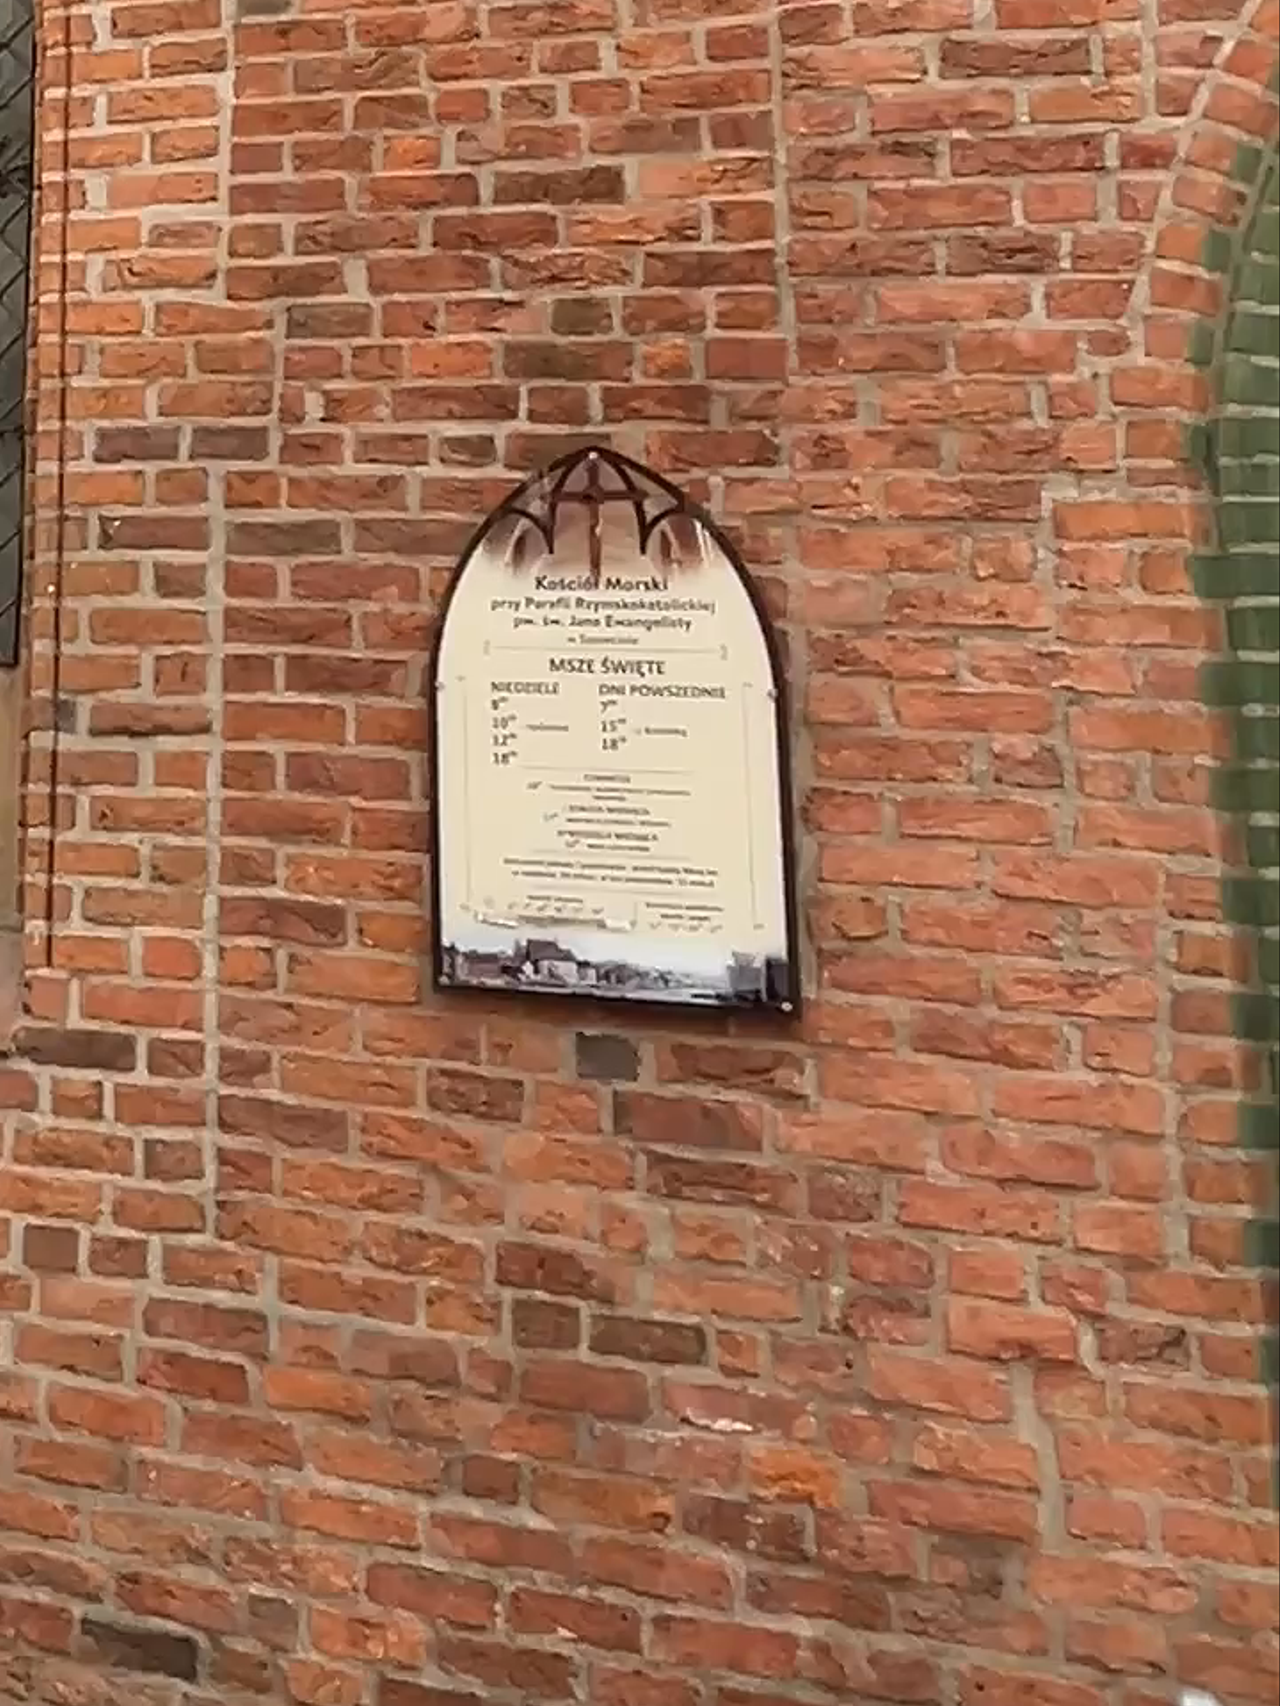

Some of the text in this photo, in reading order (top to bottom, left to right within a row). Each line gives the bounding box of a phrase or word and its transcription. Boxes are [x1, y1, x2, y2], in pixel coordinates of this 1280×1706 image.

[535, 575, 600, 591] Kościół
[491, 598, 520, 612] przy
[549, 658, 666, 677] MSZE ŚWIĘTE
[491, 681, 559, 695] NIEDZIELE
[598, 683, 726, 699] DNI POWSZEDNIE
